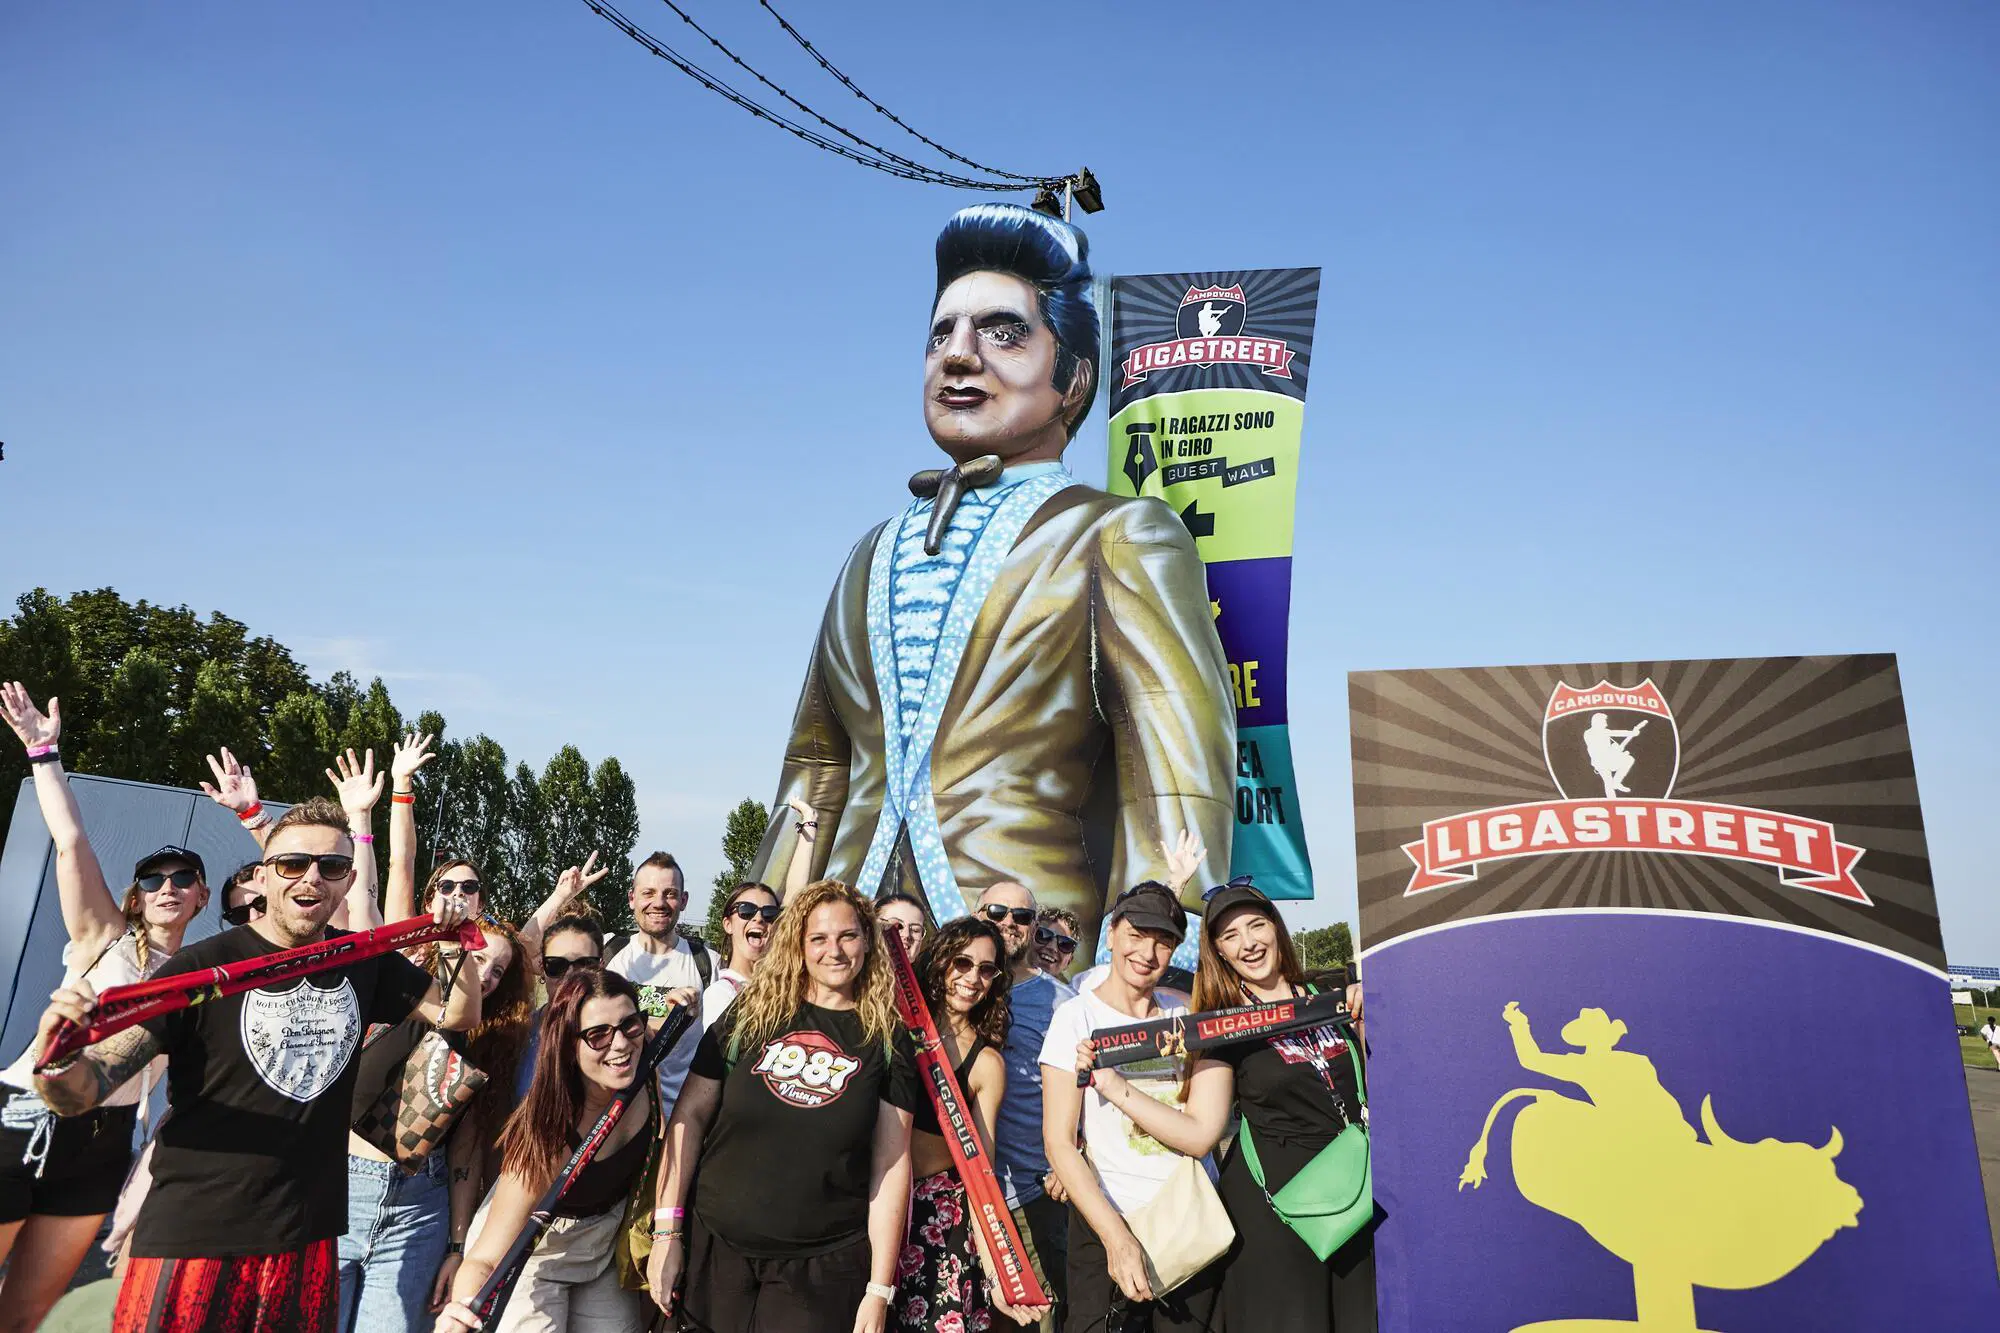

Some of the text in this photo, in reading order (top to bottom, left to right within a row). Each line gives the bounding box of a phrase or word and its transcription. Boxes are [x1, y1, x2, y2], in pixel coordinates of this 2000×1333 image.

[1186, 290, 1241, 302] CAMPOVOLO
[1133, 340, 1281, 371] LIGASTREET
[1160, 411, 1275, 435] I RAGAZZI SONO
[1161, 438, 1213, 459] IN GIRO
[1168, 462, 1269, 482] GUEST WALL
[1231, 661, 1261, 708] RE
[1554, 693, 1660, 712] CAMPOVOLO
[1237, 741, 1264, 778] EA
[1238, 787, 1286, 825] ORT
[1436, 806, 1818, 865] LIGASTREET
[286, 995, 322, 1007] CHANDON
[1203, 1007, 1291, 1035] LIGABUE
[1223, 1032, 1234, 1040] LA
[1235, 1028, 1261, 1038] NOTTE
[1094, 1031, 1148, 1048] POVOLO
[756, 1042, 859, 1091] 1987
[779, 1082, 822, 1105] Vintage
[932, 1067, 977, 1156] LIGABUE
[983, 1203, 1007, 1250] CERTE
[1002, 1253, 1026, 1300] NOTTI
